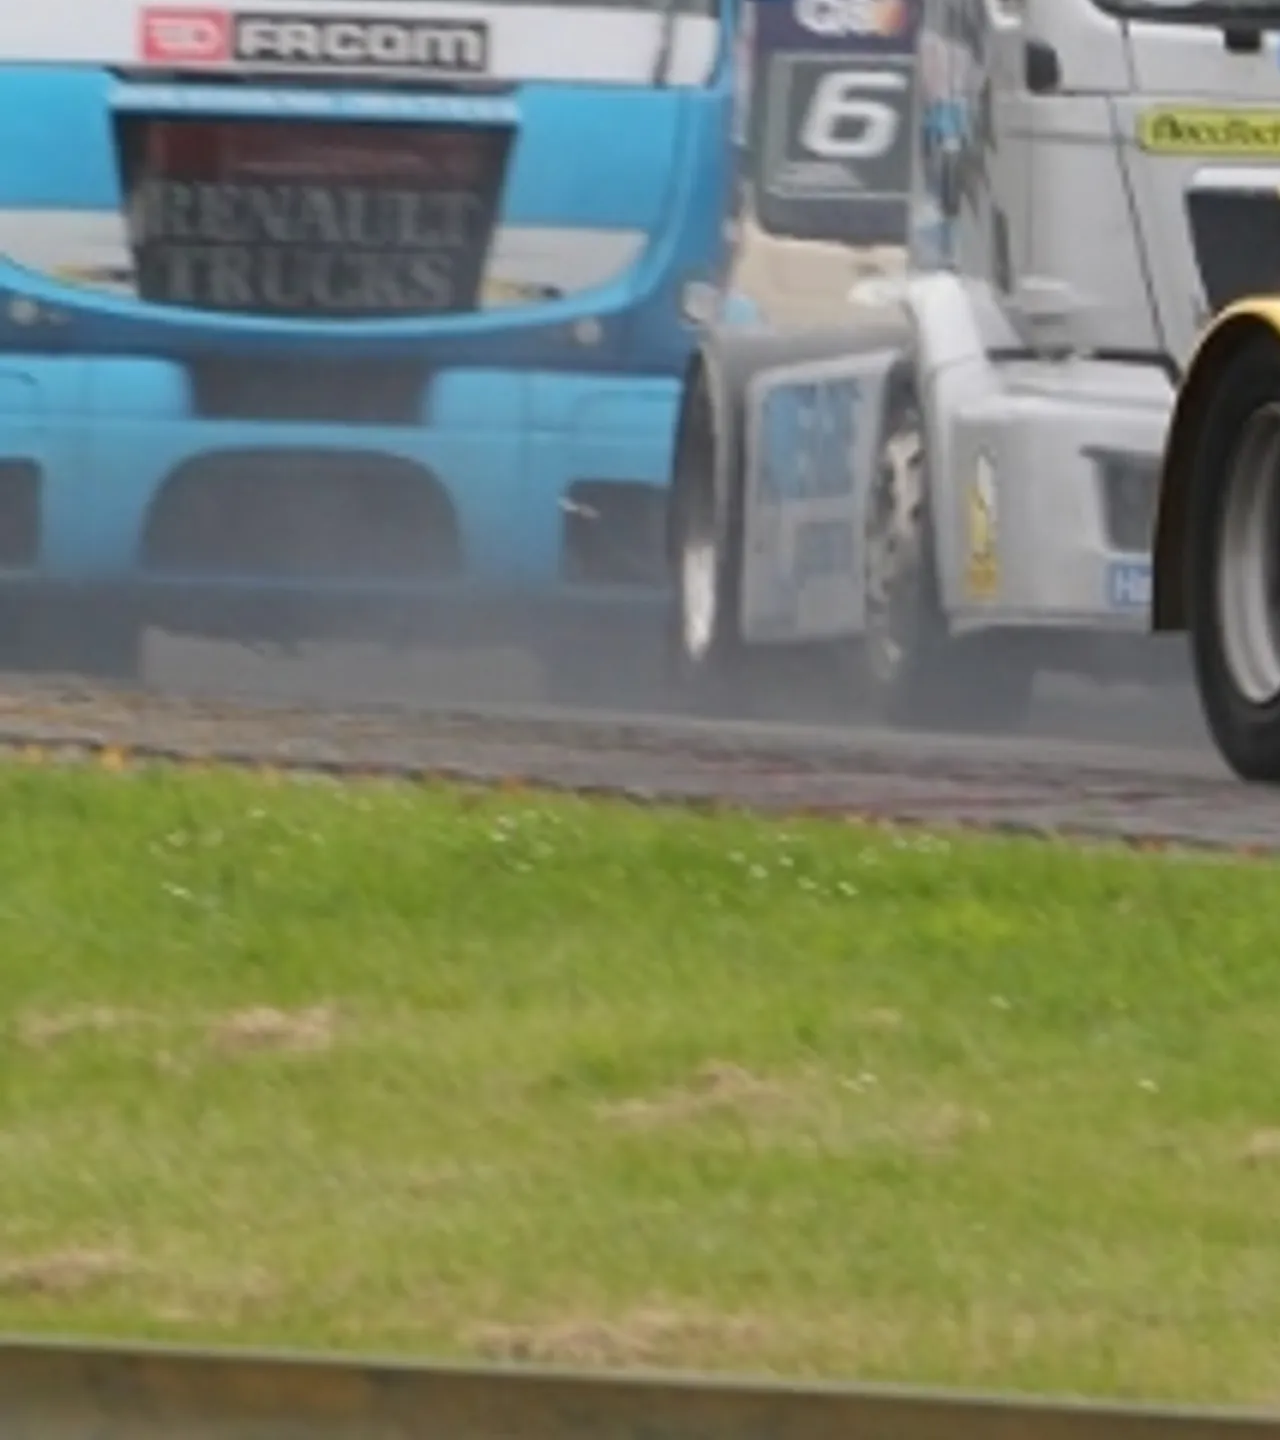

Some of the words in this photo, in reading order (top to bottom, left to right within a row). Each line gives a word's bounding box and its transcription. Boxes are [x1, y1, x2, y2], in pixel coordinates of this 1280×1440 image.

[803, 71, 908, 159] 6
[135, 180, 480, 248] RENAULT
[160, 246, 455, 310] TRUCKS
